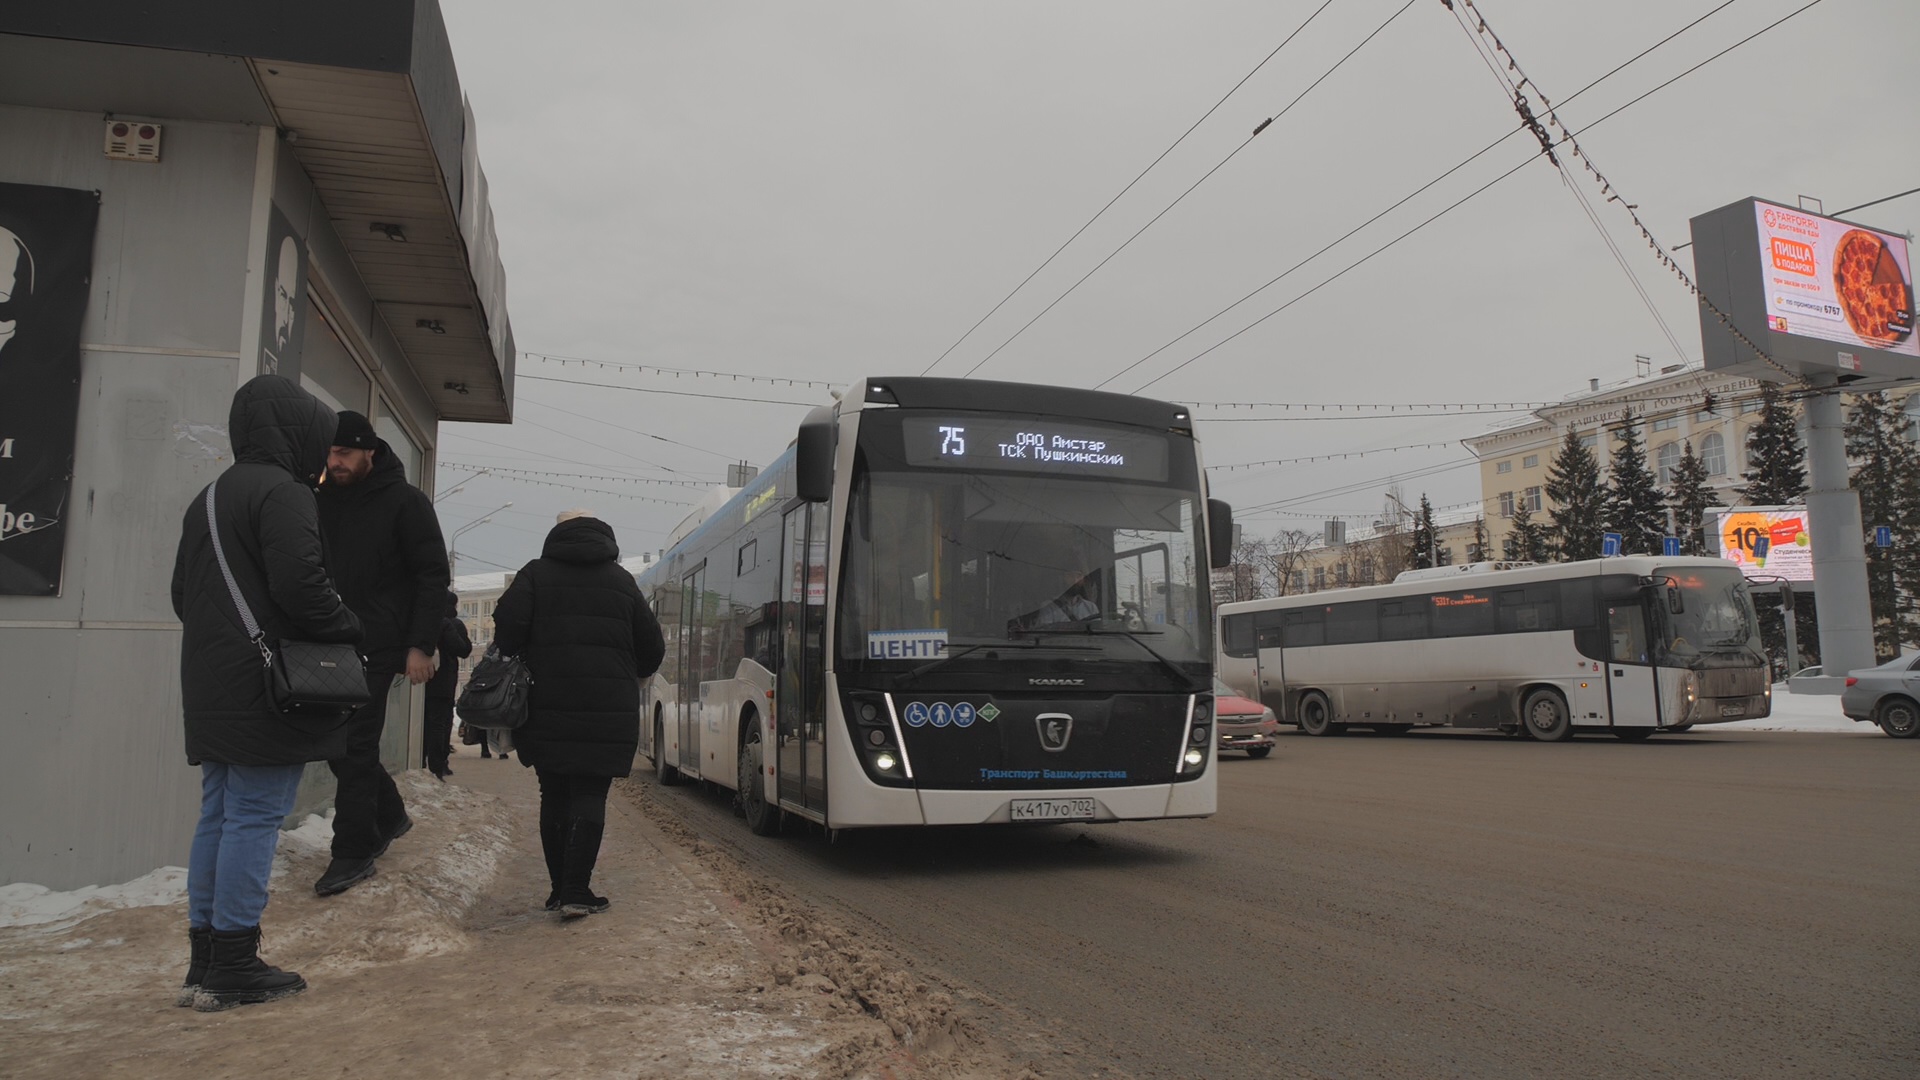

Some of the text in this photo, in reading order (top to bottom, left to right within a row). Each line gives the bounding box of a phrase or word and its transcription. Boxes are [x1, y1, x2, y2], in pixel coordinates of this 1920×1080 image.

[1774, 241, 1812, 262] ПИЦЦА
[1824, 304, 1841, 316] 6767
[939, 426, 965, 455] 75
[1016, 432, 1106, 453] ОАО Амстар
[998, 444, 1124, 466] ТСК Пушкинский
[869, 639, 947, 660] ЦЕНТР
[1028, 678, 1085, 686] KAMAZ
[980, 768, 1040, 780] Транспорт
